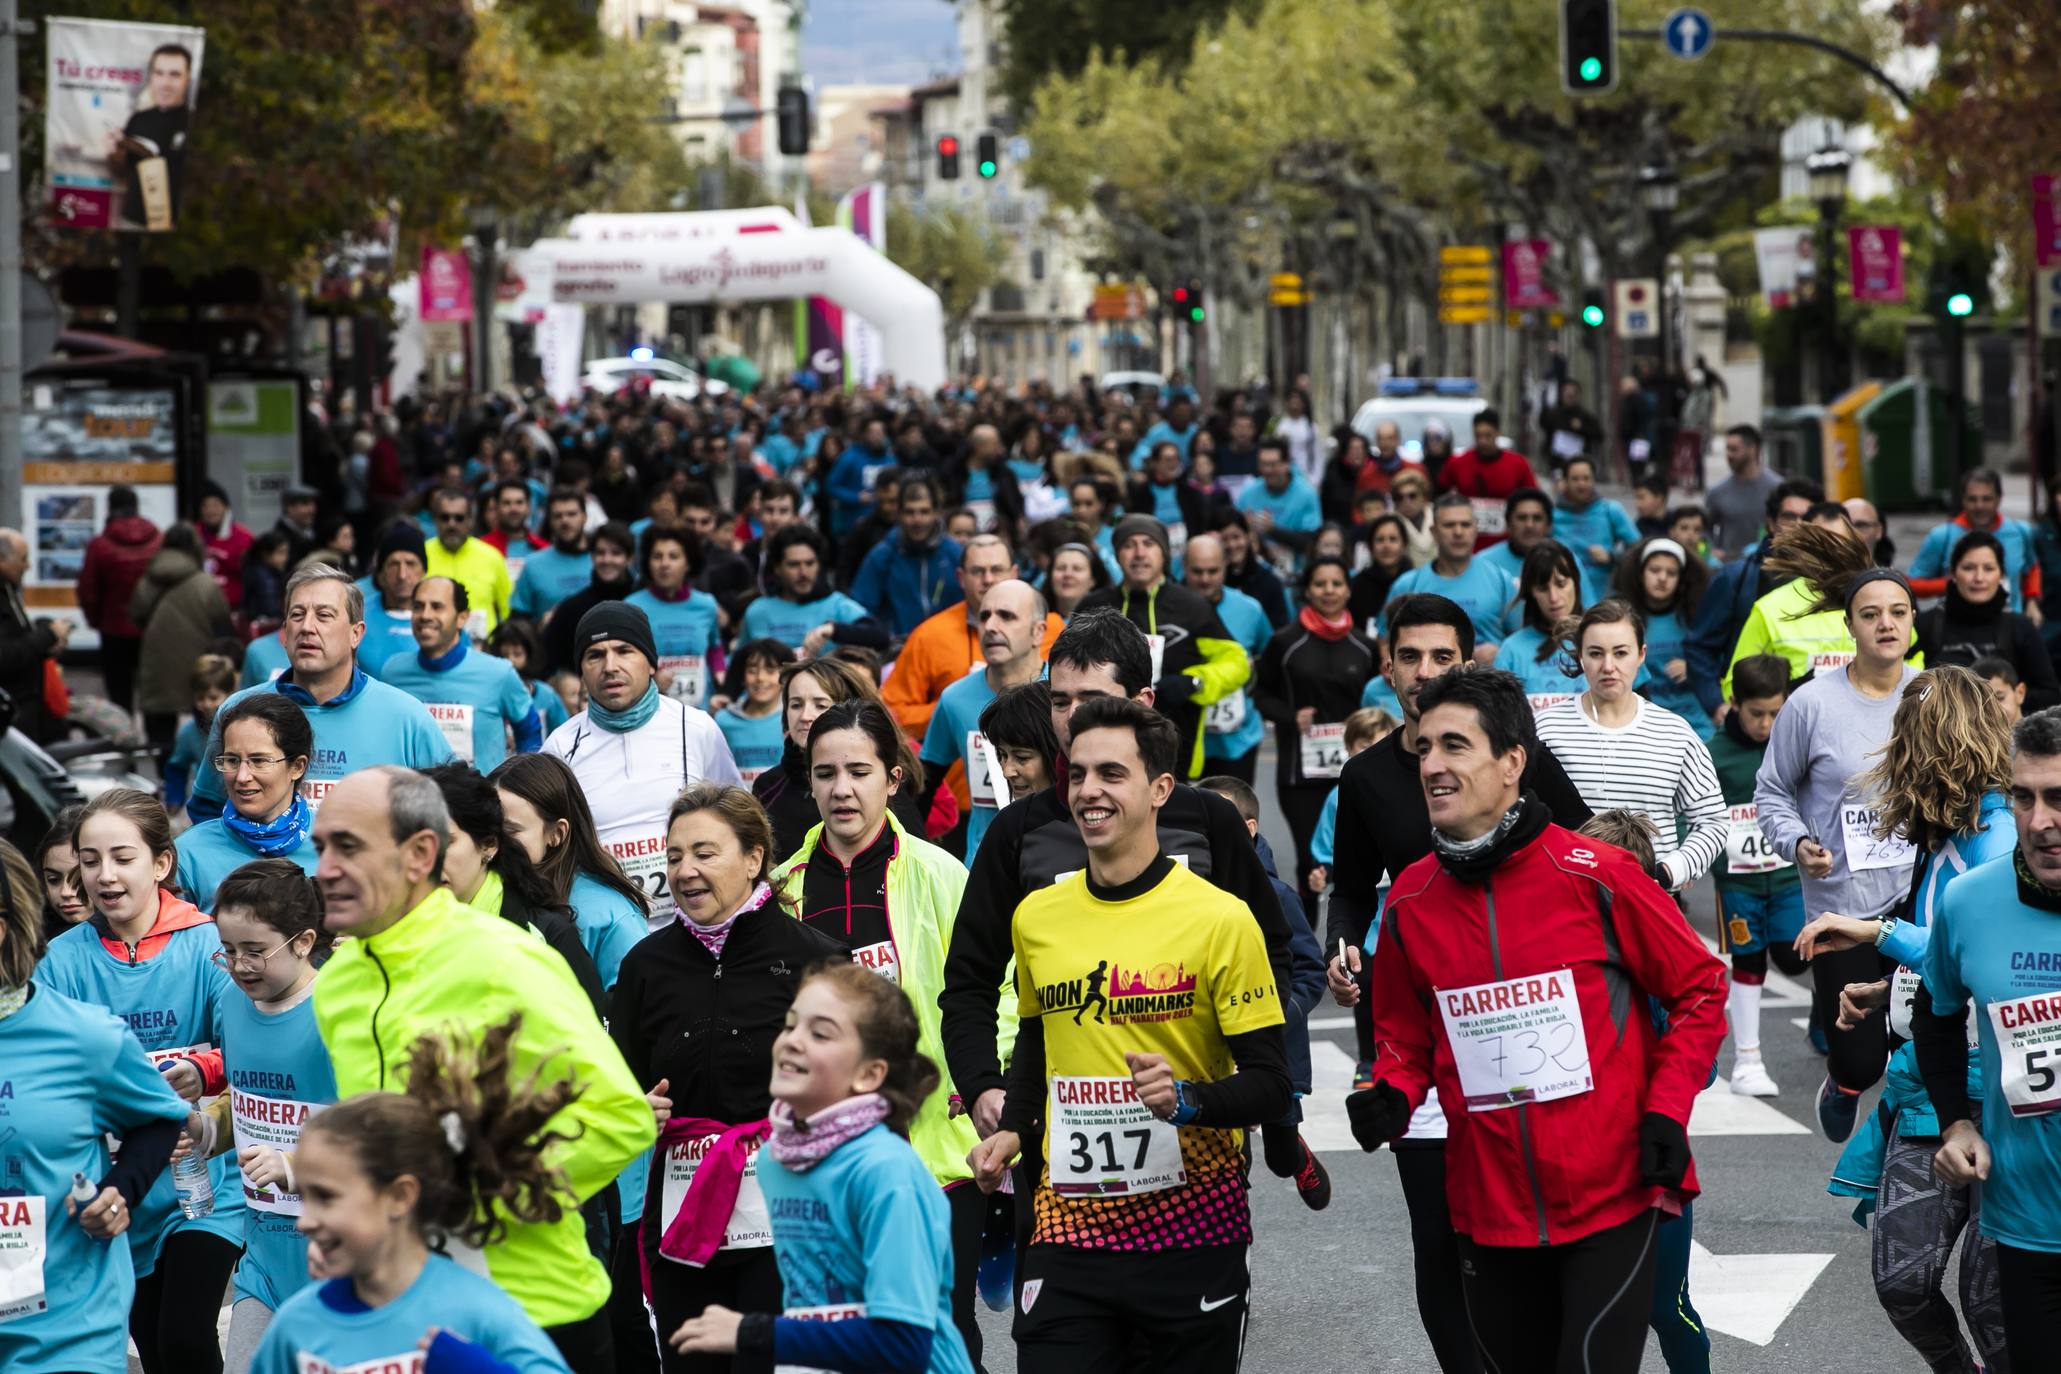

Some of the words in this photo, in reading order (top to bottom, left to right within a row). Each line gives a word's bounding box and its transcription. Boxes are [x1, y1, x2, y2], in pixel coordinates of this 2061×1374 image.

[85, 65, 143, 84] creas
[1109, 992, 1195, 1016] LANDMARKS
[1447, 976, 1565, 1018] CARRERA
[1129, 1012, 1171, 1025] MARATHON
[1459, 1021, 1471, 1029] POR
[1520, 1011, 1529, 1019] LA
[1531, 1006, 1560, 1017] FAMILIA
[1470, 1028, 1484, 1036] VIDA
[1485, 1022, 1523, 1035] SALUDABLE
[1536, 1017, 1545, 1025] LA
[1546, 1013, 1567, 1024] RIOJA
[1477, 1022, 1590, 1079] 732
[233, 1070, 296, 1091] CARRERA
[1538, 1079, 1579, 1095] LABORAL
[233, 1091, 310, 1126] CARRERA
[1080, 1108, 1114, 1116] EDUCACIÓN,
[1083, 1117, 1118, 1125] SALUDABLE
[1070, 1128, 1152, 1174] 317
[1131, 1174, 1173, 1187] LABORAL
[731, 1232, 772, 1241] LABORAL
